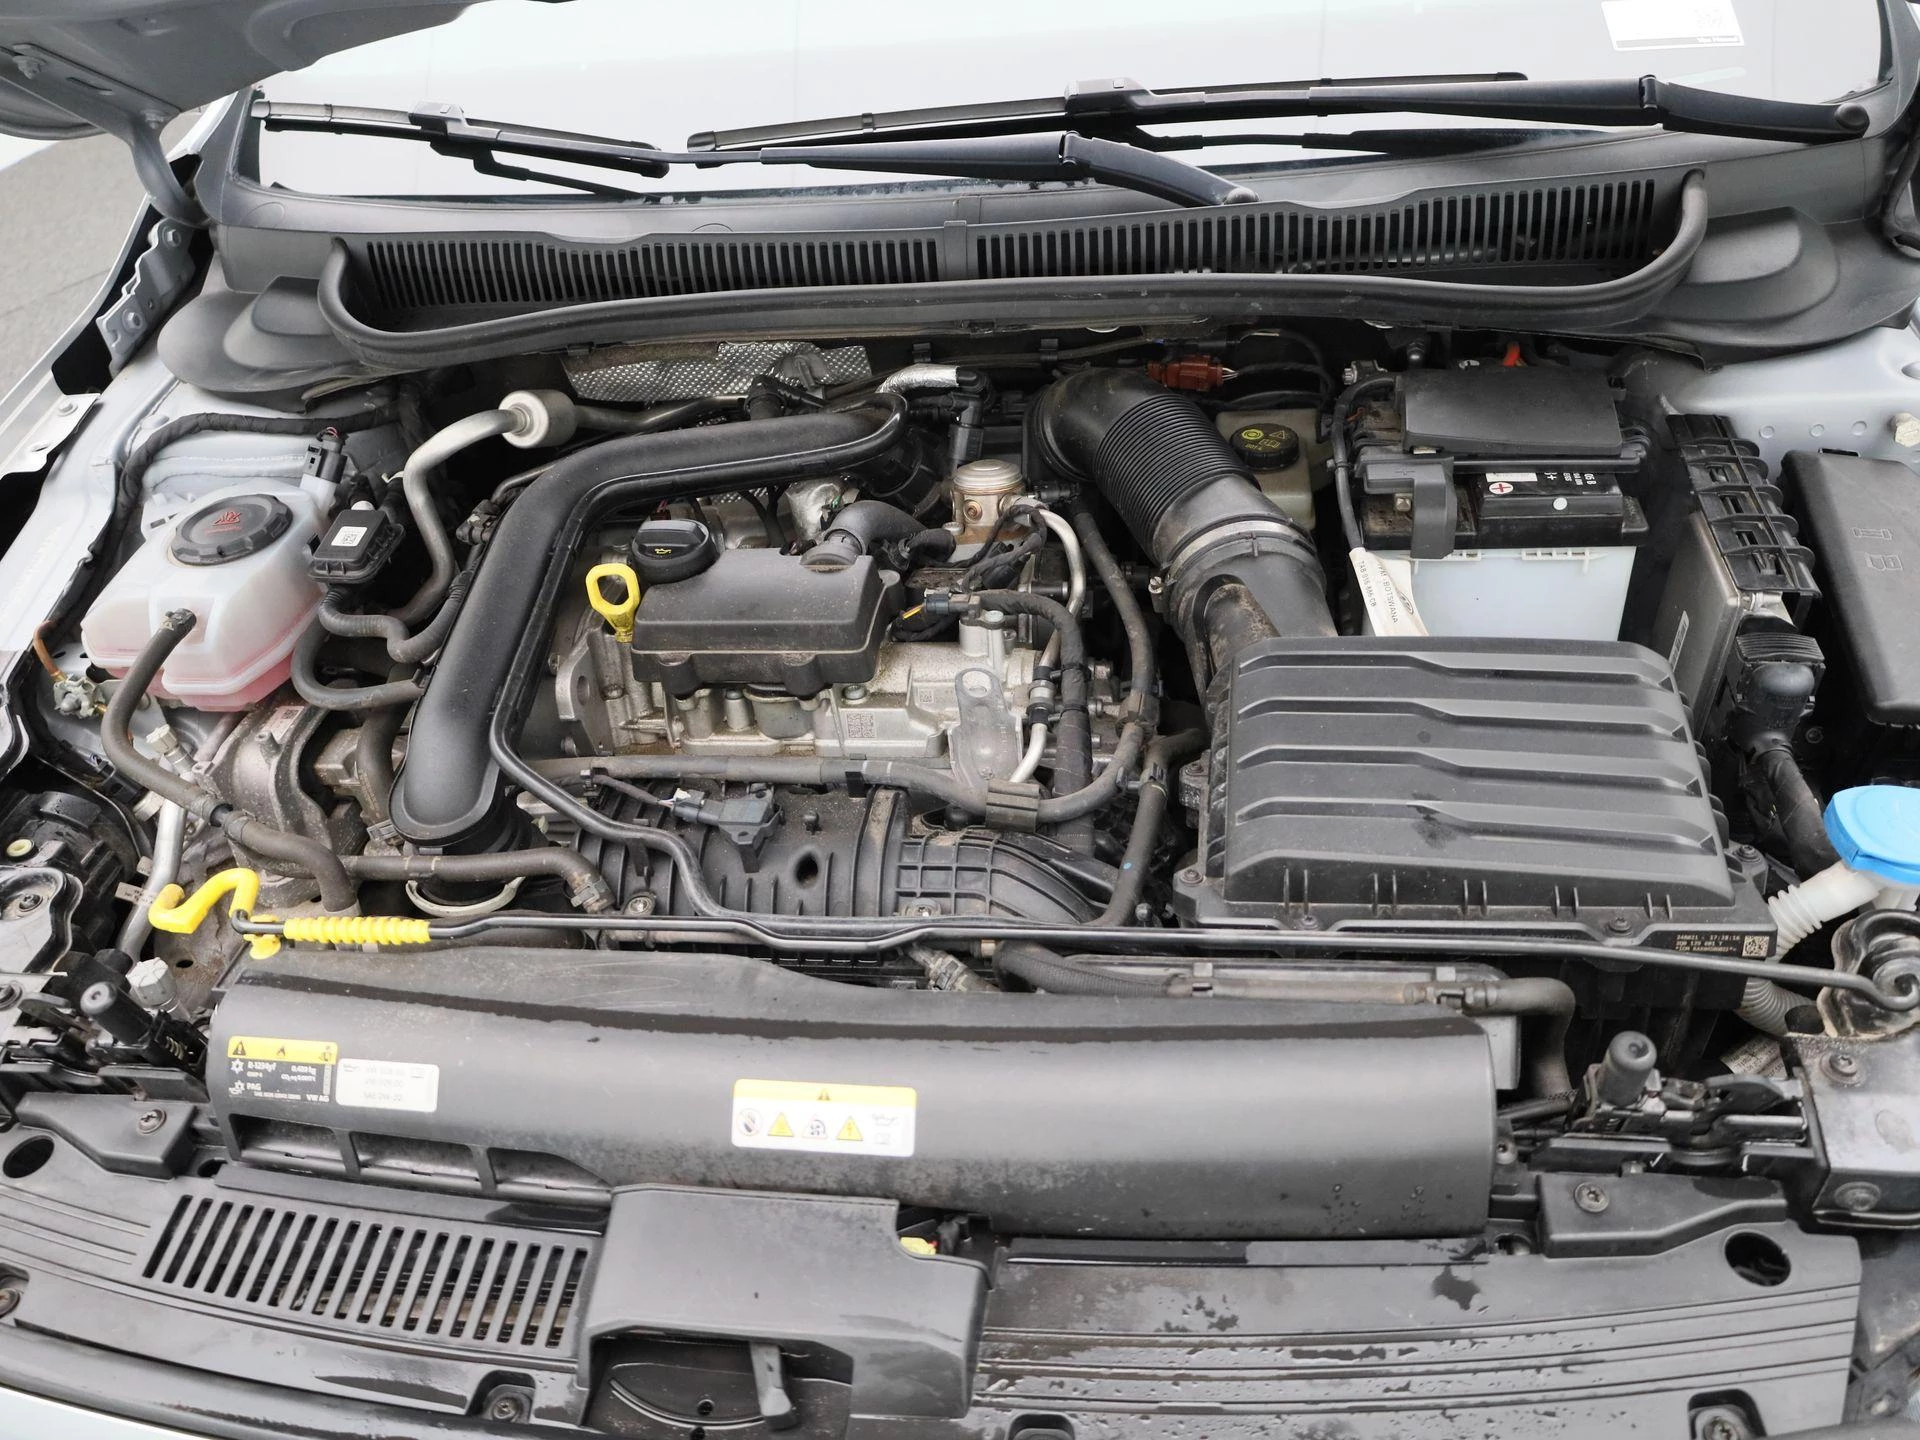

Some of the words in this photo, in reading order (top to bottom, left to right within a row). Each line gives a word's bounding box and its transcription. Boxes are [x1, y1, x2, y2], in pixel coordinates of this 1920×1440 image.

[1383, 581, 1399, 624] BOTSWANA
[246, 1083, 261, 1091] PAG
[306, 1094, 318, 1102] VW
[318, 1095, 330, 1103] AG
